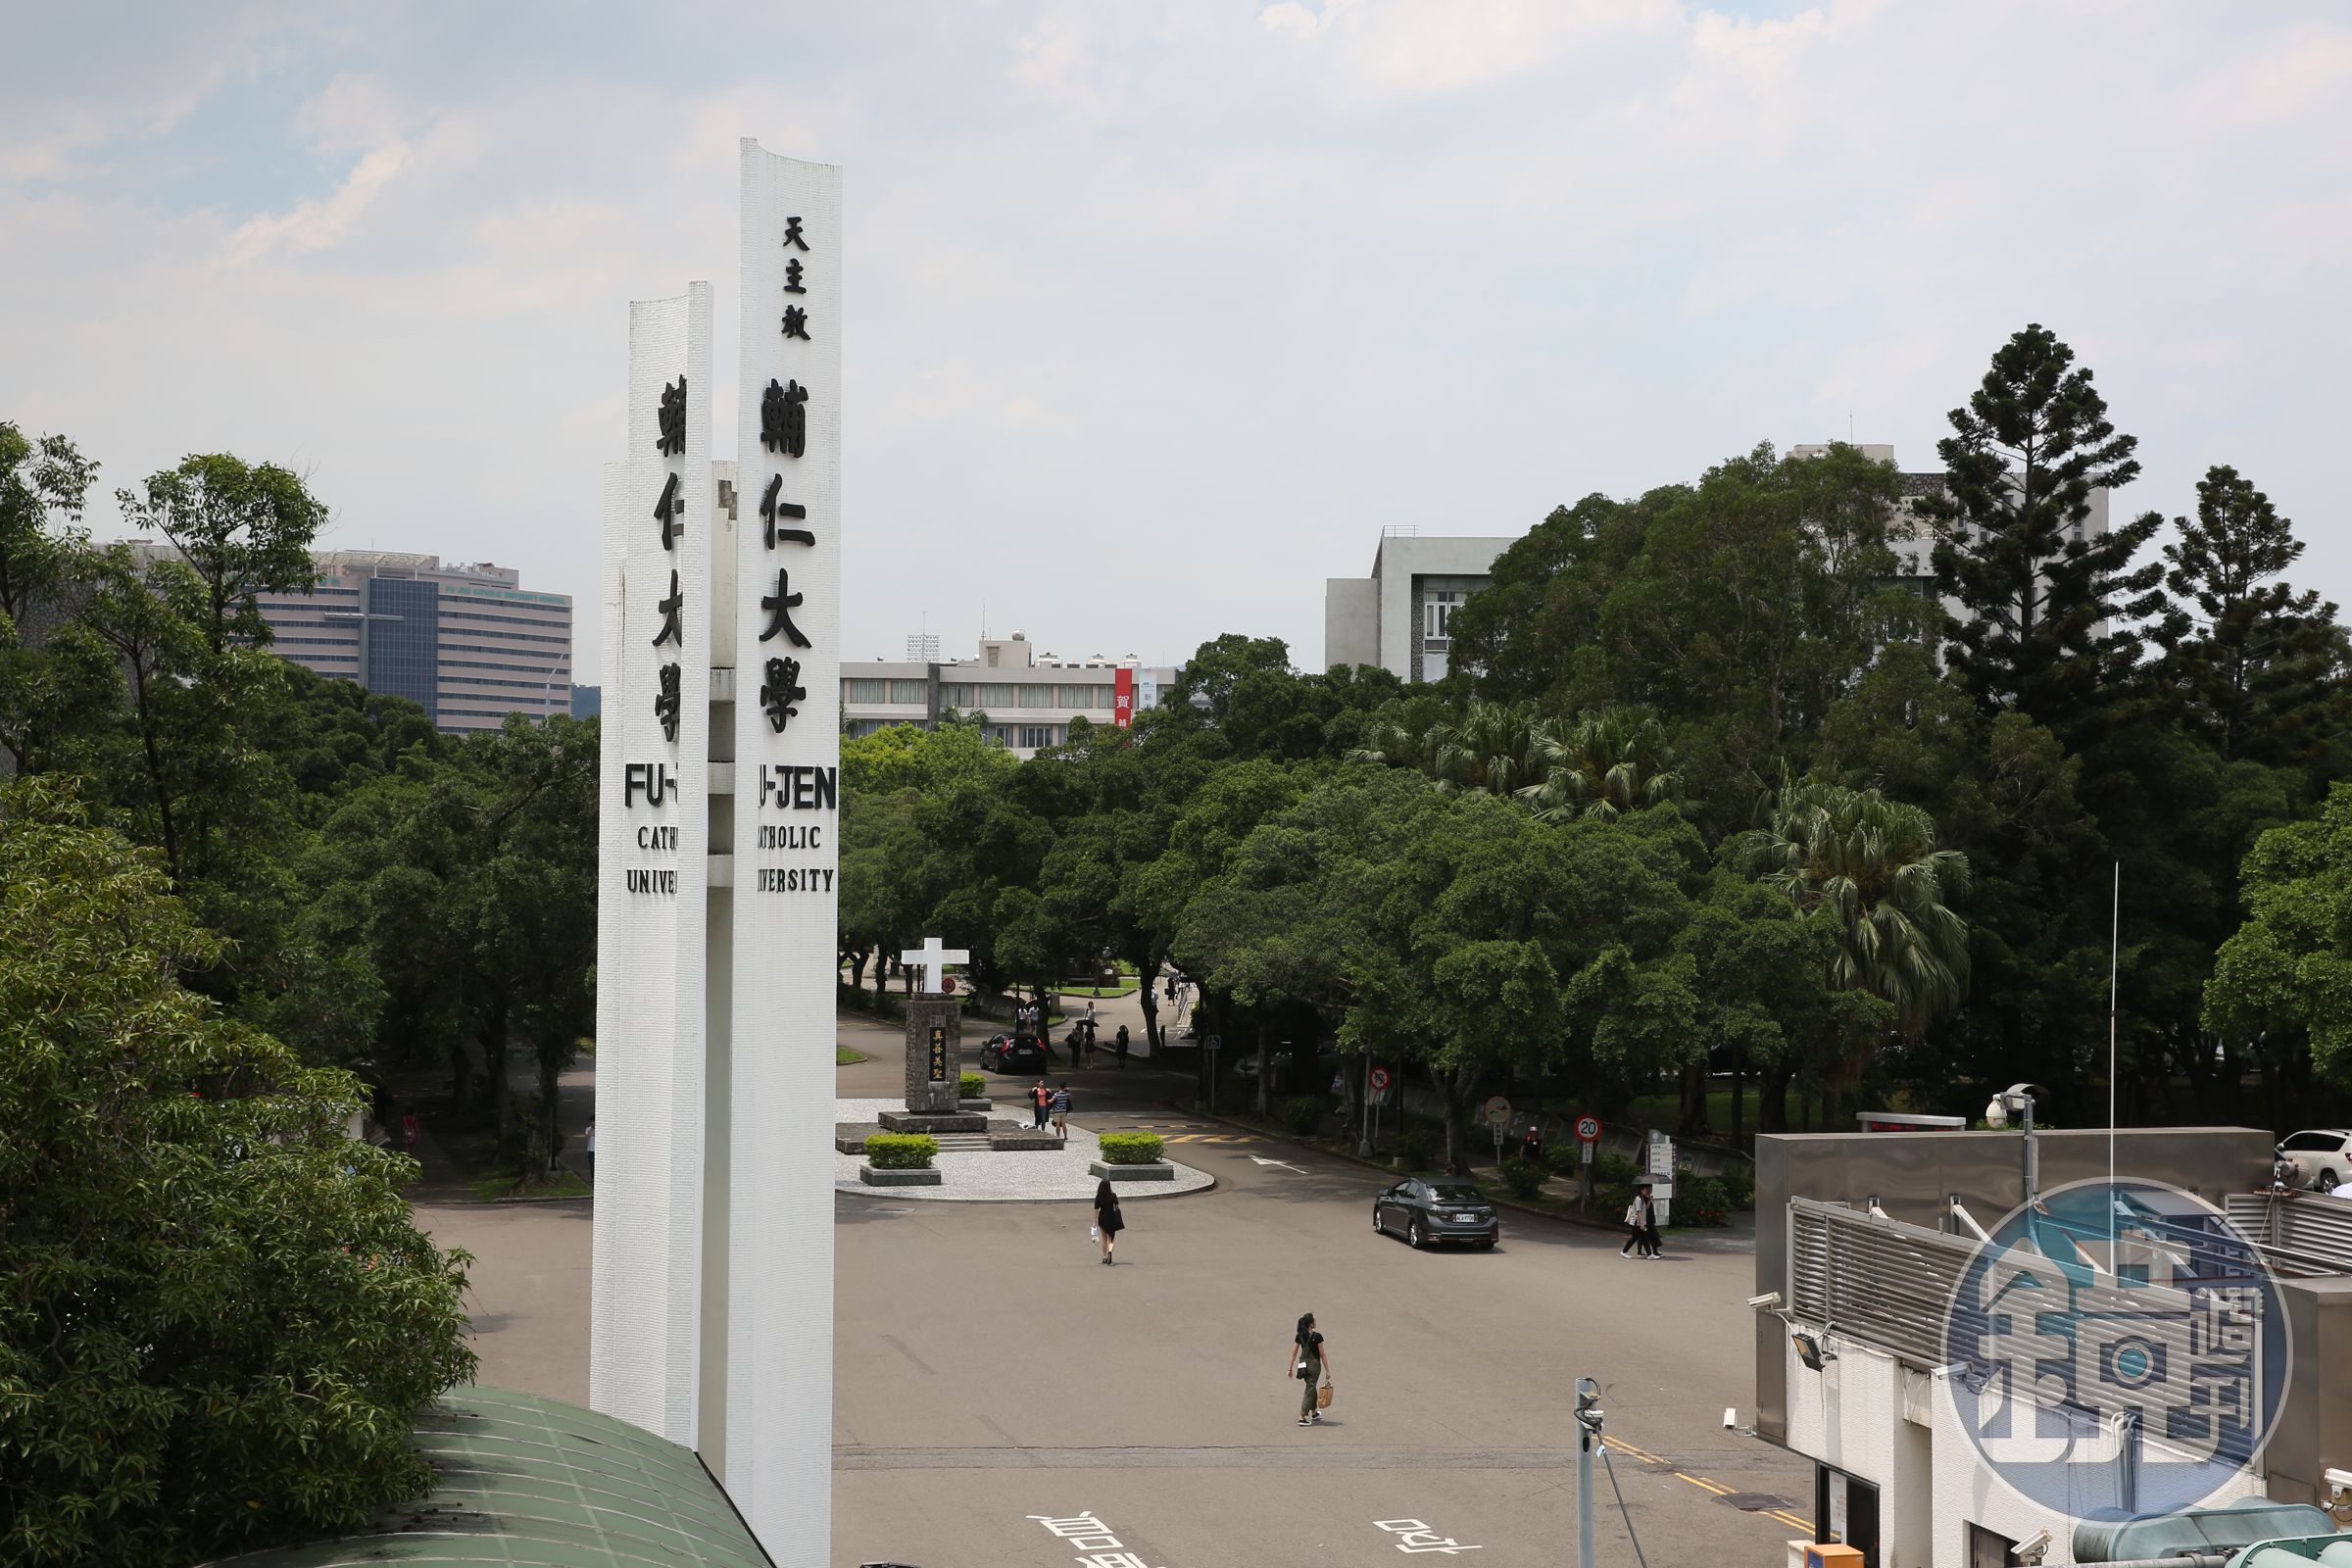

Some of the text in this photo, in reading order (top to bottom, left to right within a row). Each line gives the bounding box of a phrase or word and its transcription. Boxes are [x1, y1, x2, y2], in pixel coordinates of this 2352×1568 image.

[782, 217, 811, 340] 天主教
[760, 378, 816, 734] 輔仁大學
[624, 762, 678, 808] FU-
[637, 826, 678, 850] CATH
[627, 869, 677, 894] UNIVE
[1581, 1121, 1596, 1135] 20
